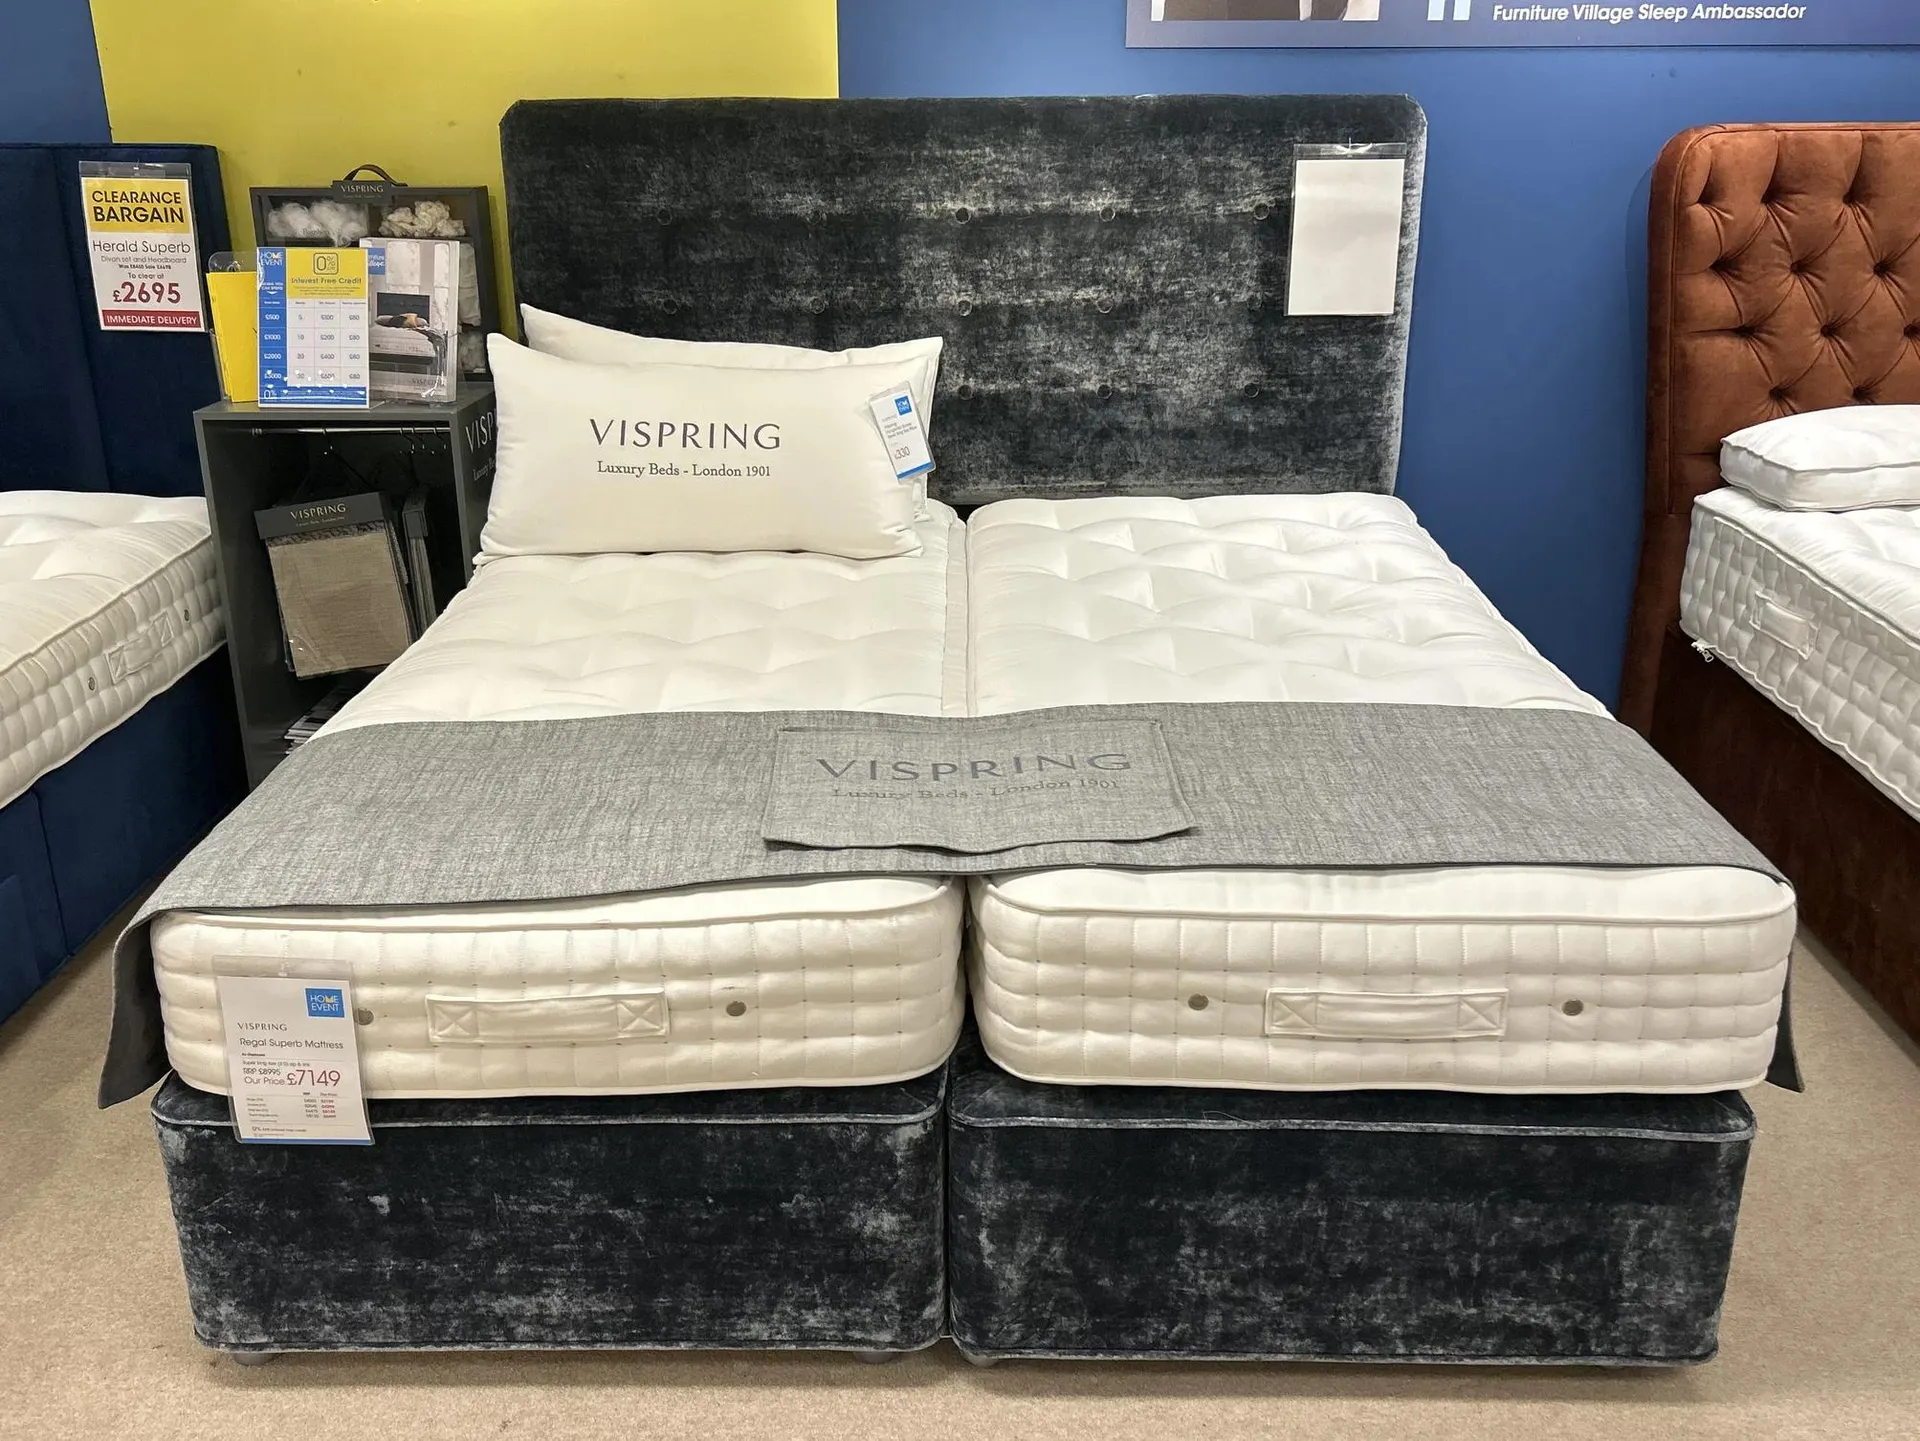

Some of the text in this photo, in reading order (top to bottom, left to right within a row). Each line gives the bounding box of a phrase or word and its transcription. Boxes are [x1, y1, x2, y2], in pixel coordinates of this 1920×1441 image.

[1493, 3, 1807, 24] Furniture Village Sleep Ambassador
[340, 184, 384, 193] VISPRING
[92, 190, 181, 204] CLEARANCE
[93, 206, 185, 223] BARGAIN
[92, 240, 191, 255] Herald Superb
[113, 281, 181, 303] £2695
[106, 314, 197, 325] IMMEDIATE DELIVERY
[589, 418, 780, 450] VISPRING
[597, 460, 646, 478] Luxury
[650, 463, 680, 476] Beds
[692, 463, 742, 477] London
[746, 465, 771, 477] 1901
[289, 503, 346, 520] VISPRING
[816, 752, 1132, 782] VISPRING
[832, 788, 914, 800] Luxury
[918, 789, 968, 799] Beds
[990, 780, 1071, 798] London
[1079, 778, 1120, 790] 1901
[310, 994, 339, 1004] HOME
[311, 1002, 340, 1012] EVENT
[237, 1022, 288, 1032] VISPRING
[240, 1037, 344, 1050] Regal Superb Mattress
[243, 1067, 281, 1076] RRP £8995
[244, 1069, 341, 1087] Our Price £7149
